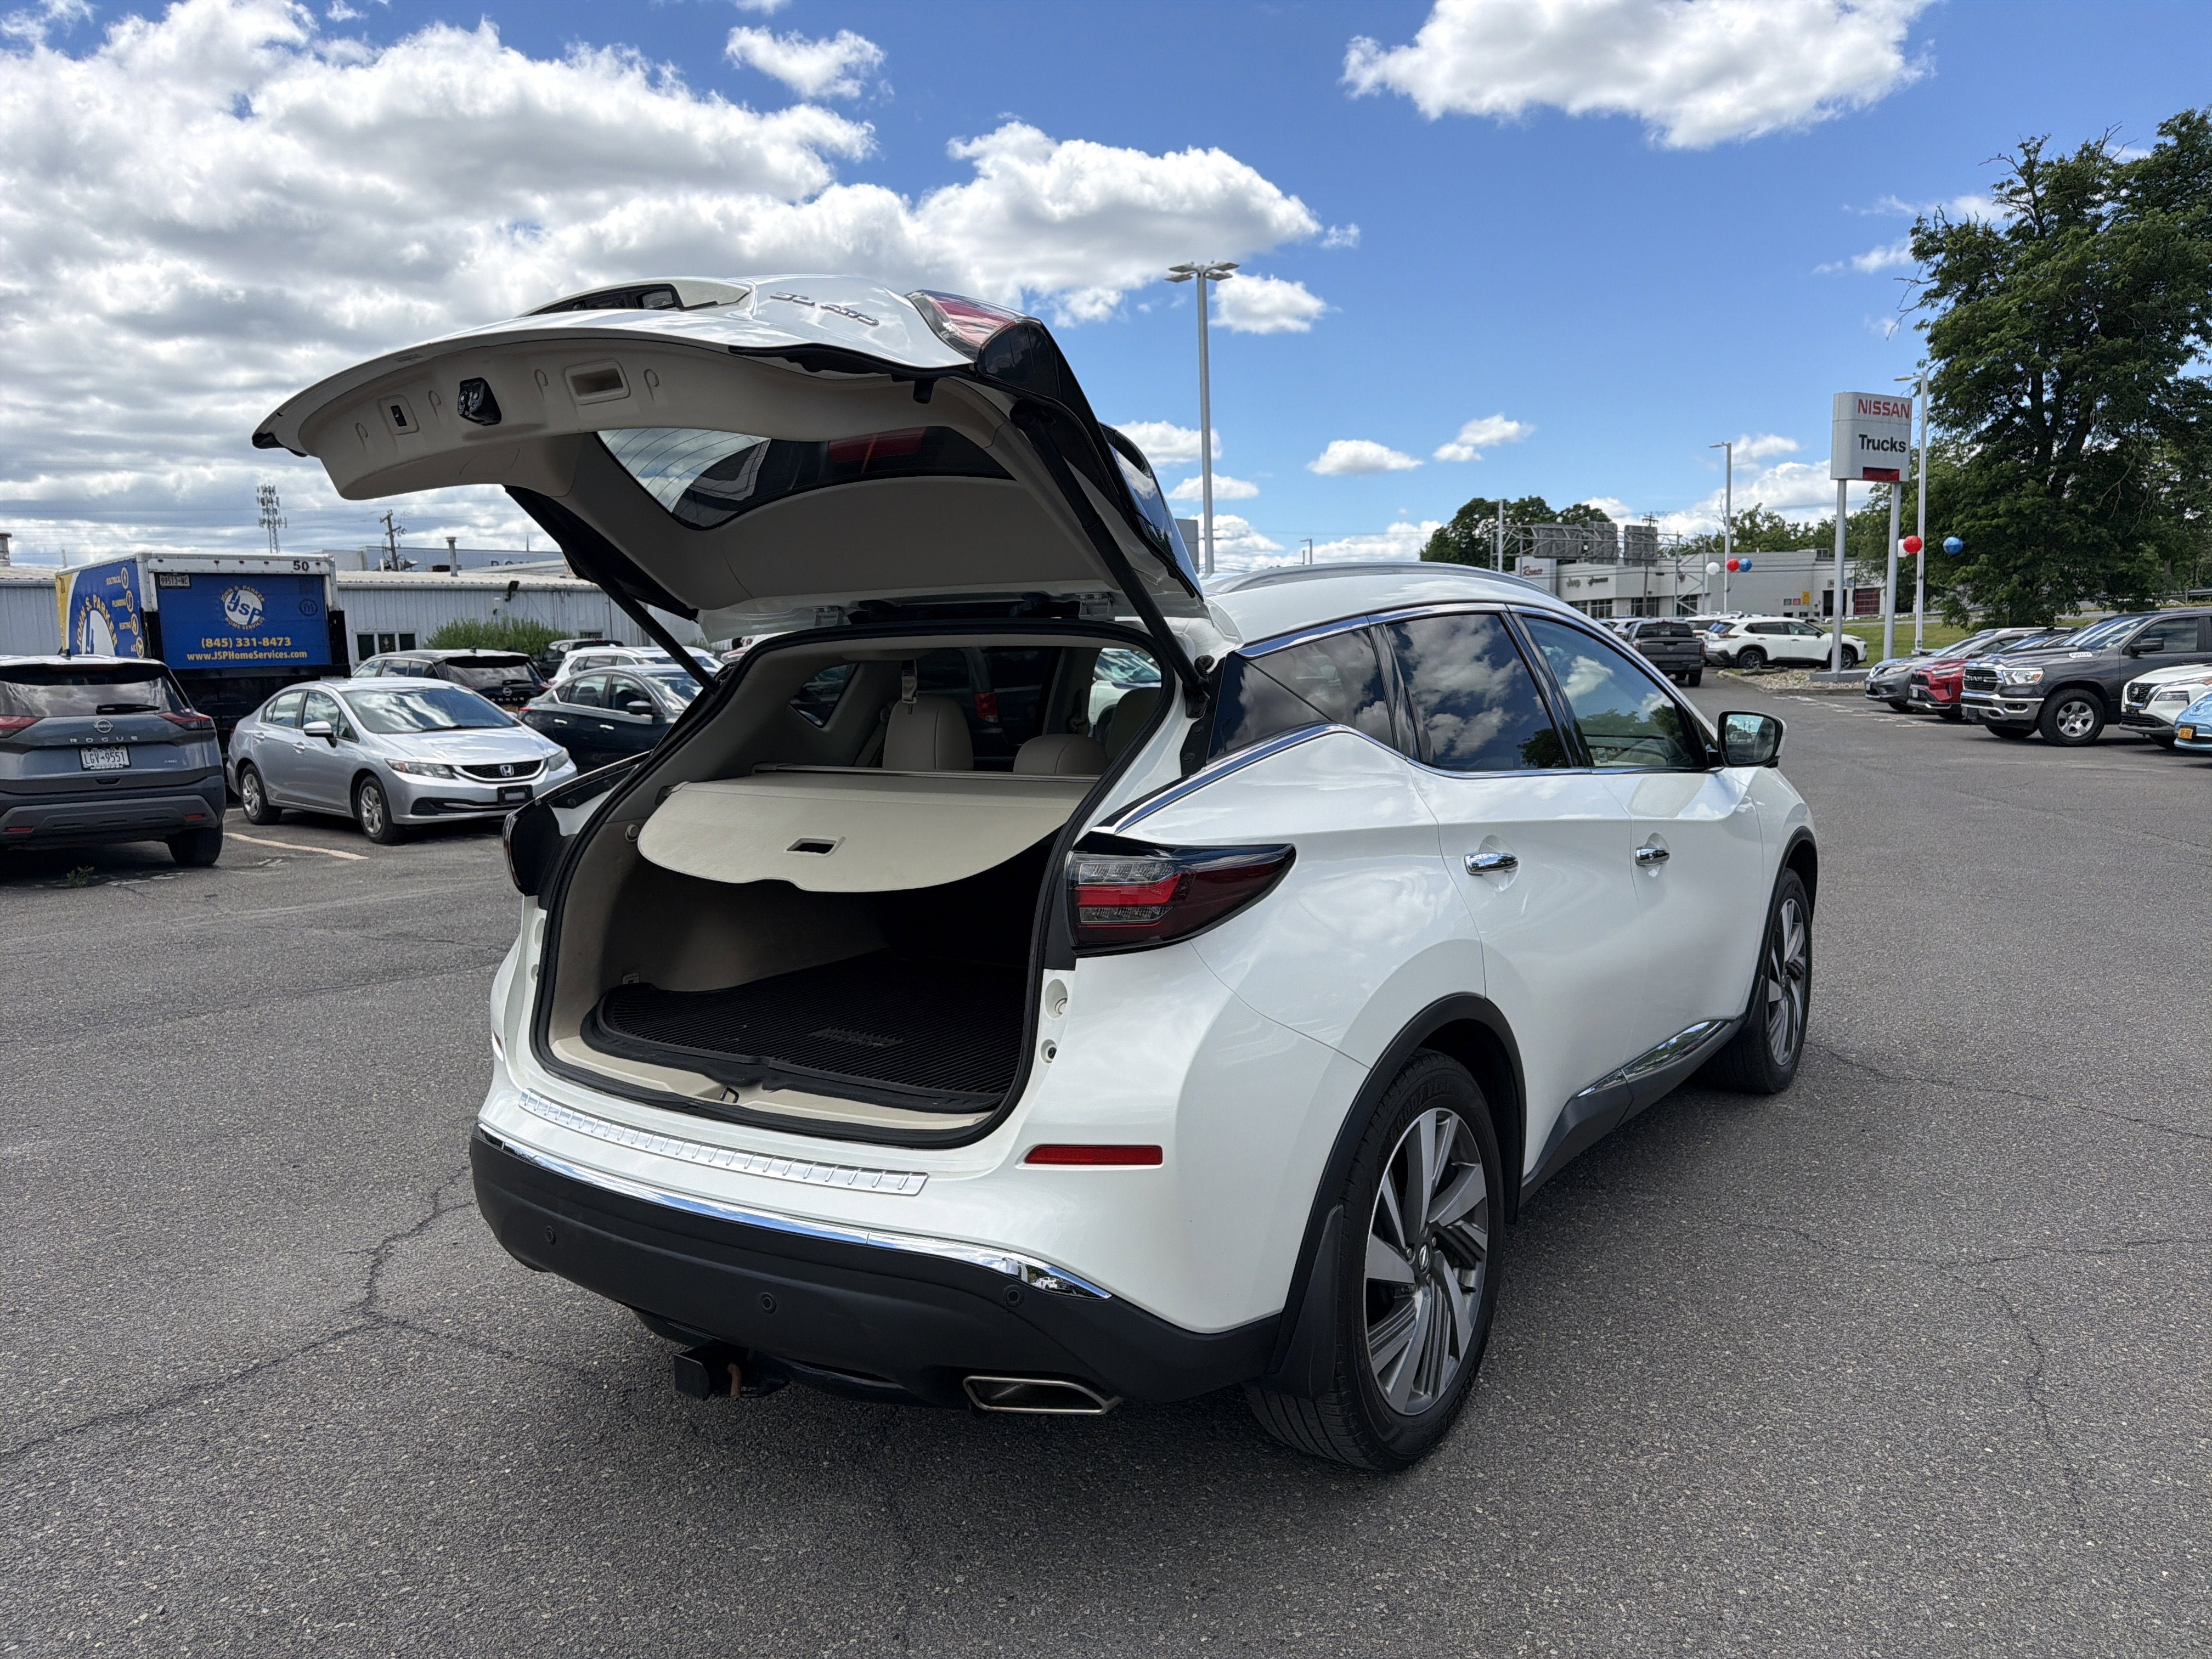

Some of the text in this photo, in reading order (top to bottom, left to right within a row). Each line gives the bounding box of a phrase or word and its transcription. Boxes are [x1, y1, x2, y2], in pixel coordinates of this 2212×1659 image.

[1858, 398, 1910, 419] NISSAN
[1858, 433, 1906, 453] Trucks
[292, 560, 310, 572] 50
[227, 590, 264, 625] JSP
[77, 594, 118, 652] JOHN S. PARKER
[201, 636, 292, 649] (845) 331-8473
[187, 650, 308, 661] www.JSPHomeServices.com
[69, 735, 138, 744] ROGUE
[83, 751, 126, 765] LGV-9551
